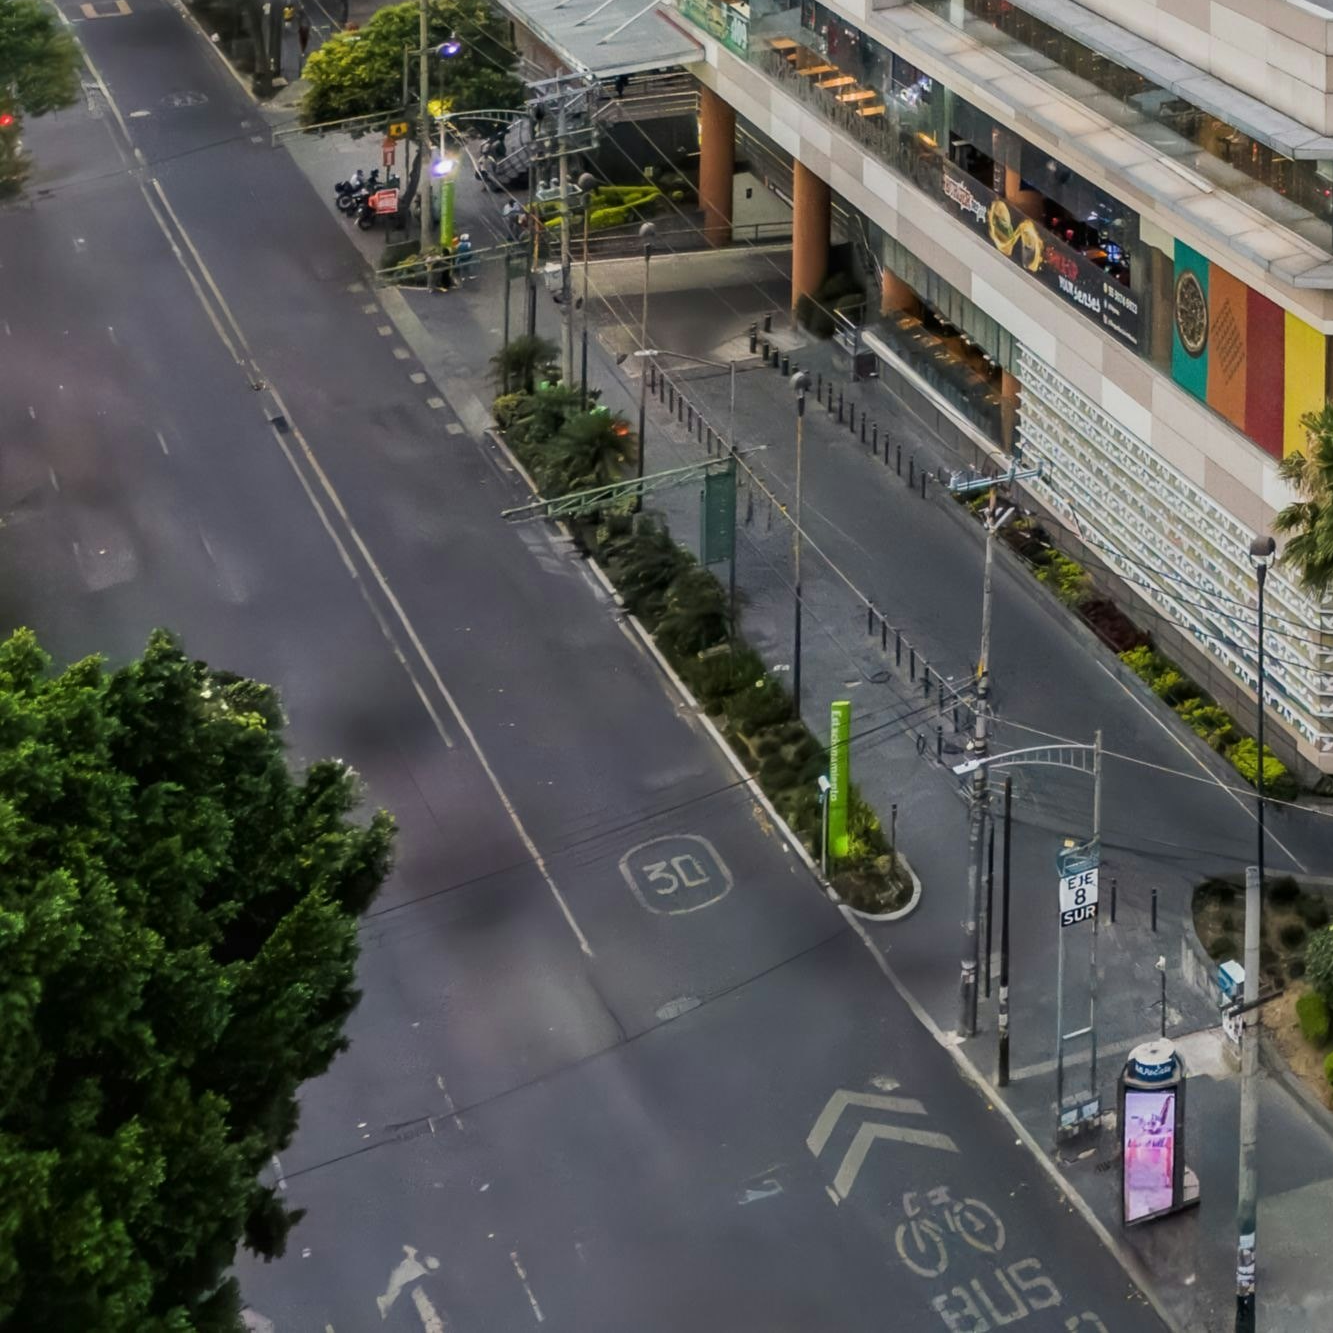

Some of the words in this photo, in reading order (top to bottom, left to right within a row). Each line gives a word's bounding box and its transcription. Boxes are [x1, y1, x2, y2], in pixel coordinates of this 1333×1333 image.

[642, 854, 710, 894] 30
[1068, 872, 1095, 890] EJE
[1074, 888, 1086, 906] 8
[1063, 905, 1096, 925] SUR
[932, 1257, 1062, 1333] BUS
